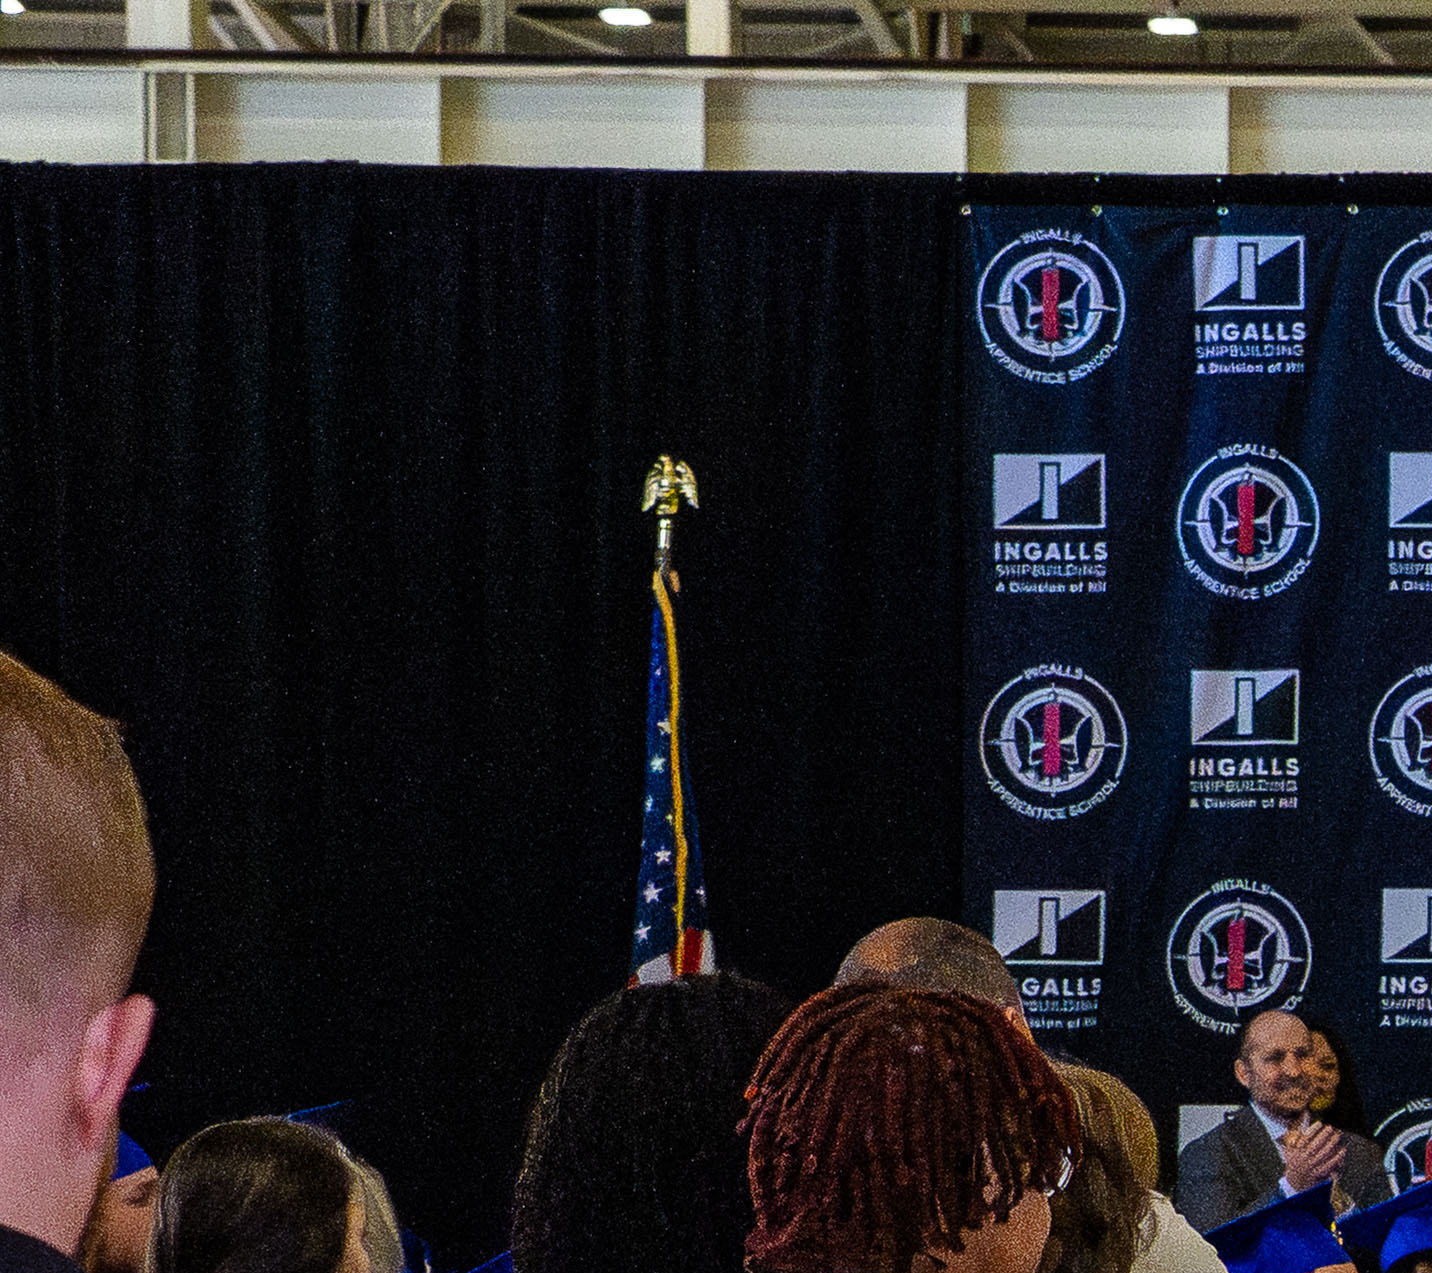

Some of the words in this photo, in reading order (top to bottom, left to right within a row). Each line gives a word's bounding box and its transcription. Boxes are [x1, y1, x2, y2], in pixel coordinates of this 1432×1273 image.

[1193, 320, 1305, 343] INGALLS
[994, 539, 1107, 563] INGALLS
[994, 563, 1107, 578] SHIPBUILDING
[1189, 755, 1299, 778] INGALLS
[1022, 977, 1101, 996] GALLS
[1380, 1015, 1392, 1028] A
